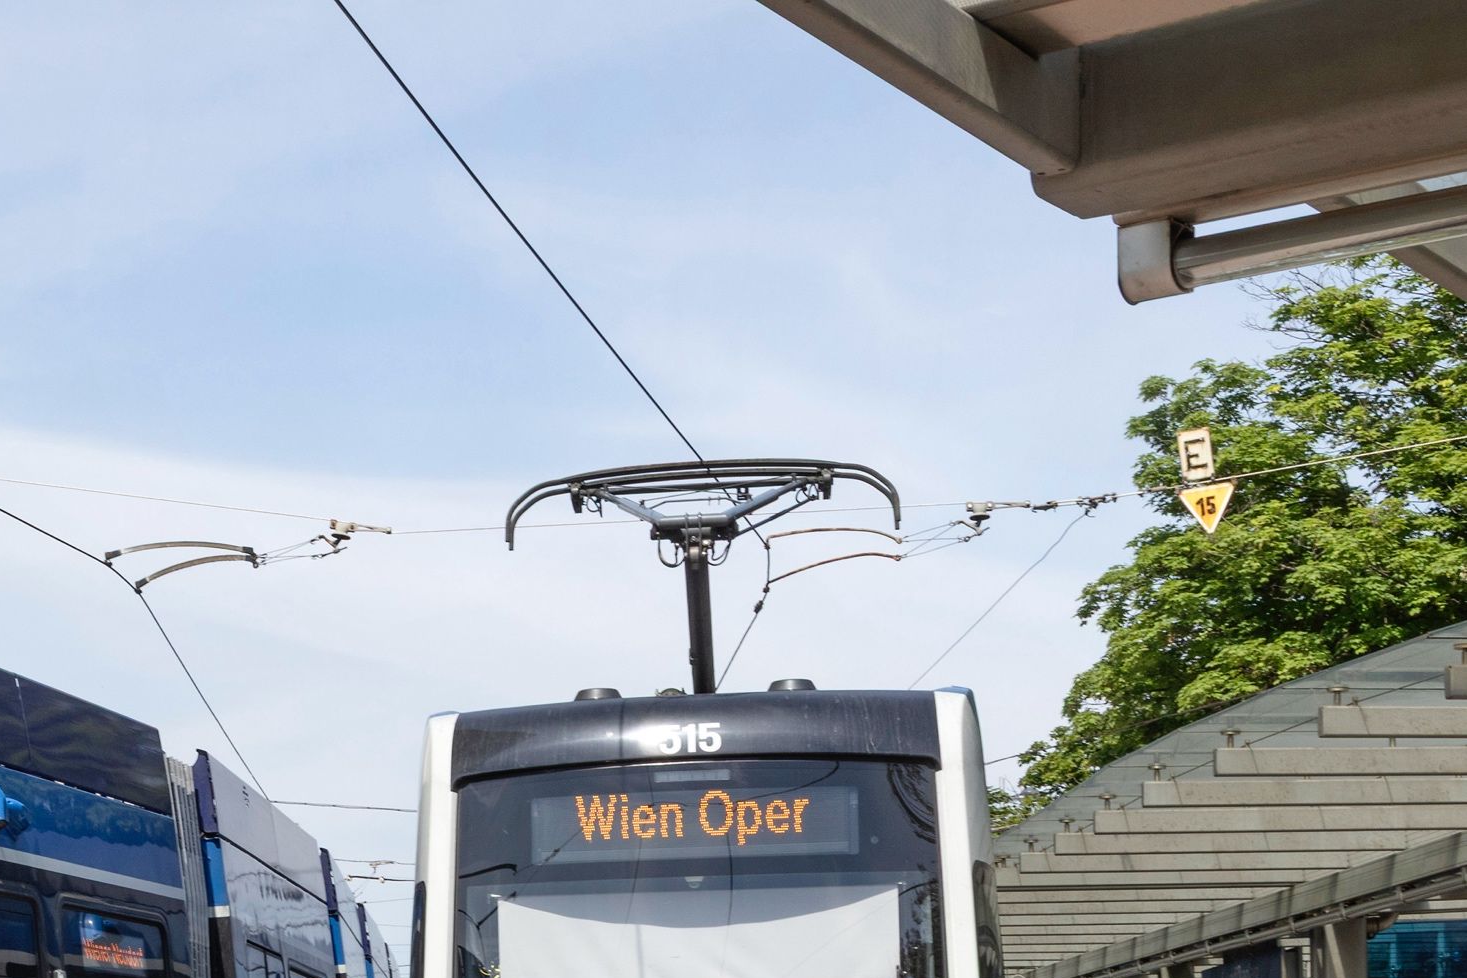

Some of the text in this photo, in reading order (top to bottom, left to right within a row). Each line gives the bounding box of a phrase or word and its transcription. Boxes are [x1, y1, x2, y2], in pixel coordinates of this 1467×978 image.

[1184, 437, 1208, 471] E
[1196, 496, 1216, 516] 15
[659, 722, 722, 755] 515
[575, 789, 810, 846] Wien Oper
